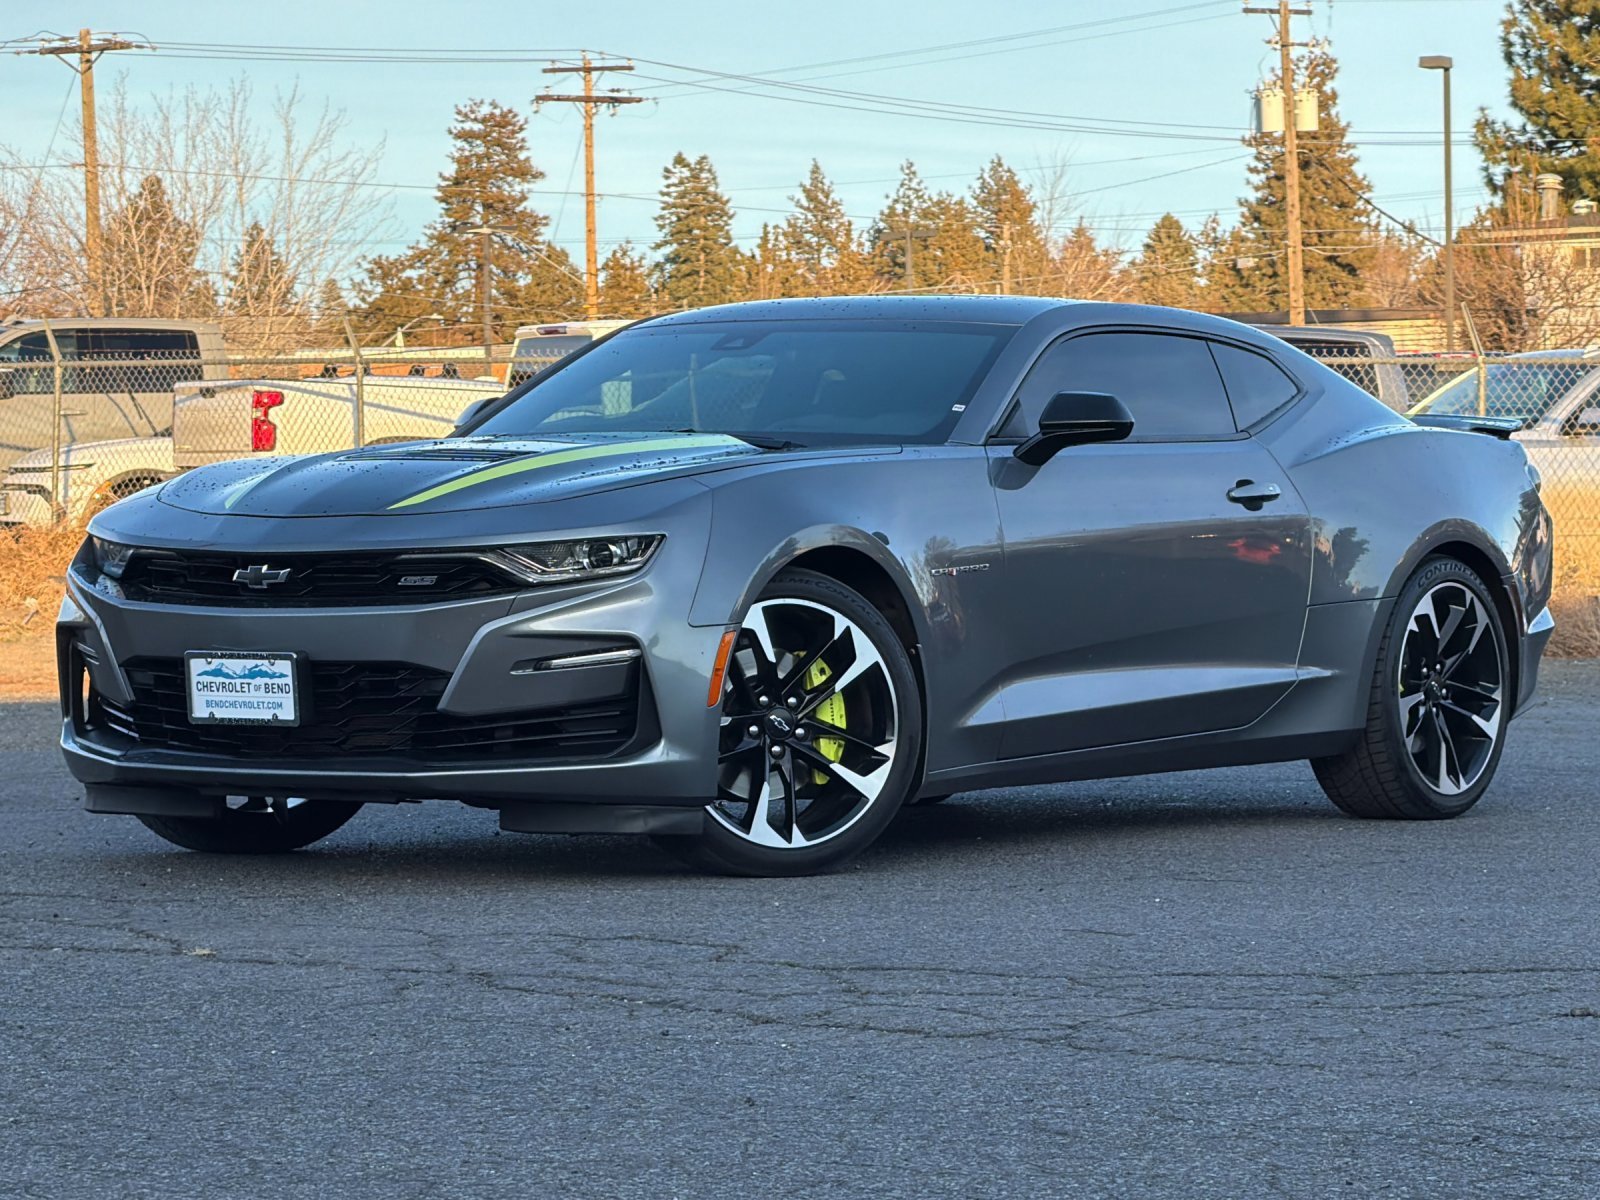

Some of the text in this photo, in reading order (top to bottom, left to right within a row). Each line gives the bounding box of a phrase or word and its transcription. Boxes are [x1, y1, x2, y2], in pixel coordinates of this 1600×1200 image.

[1417, 561, 1489, 594] CONTINEN
[196, 681, 291, 694] CHEVROLET OF BEND
[206, 699, 283, 710] BENDCHEVROLET.COM
